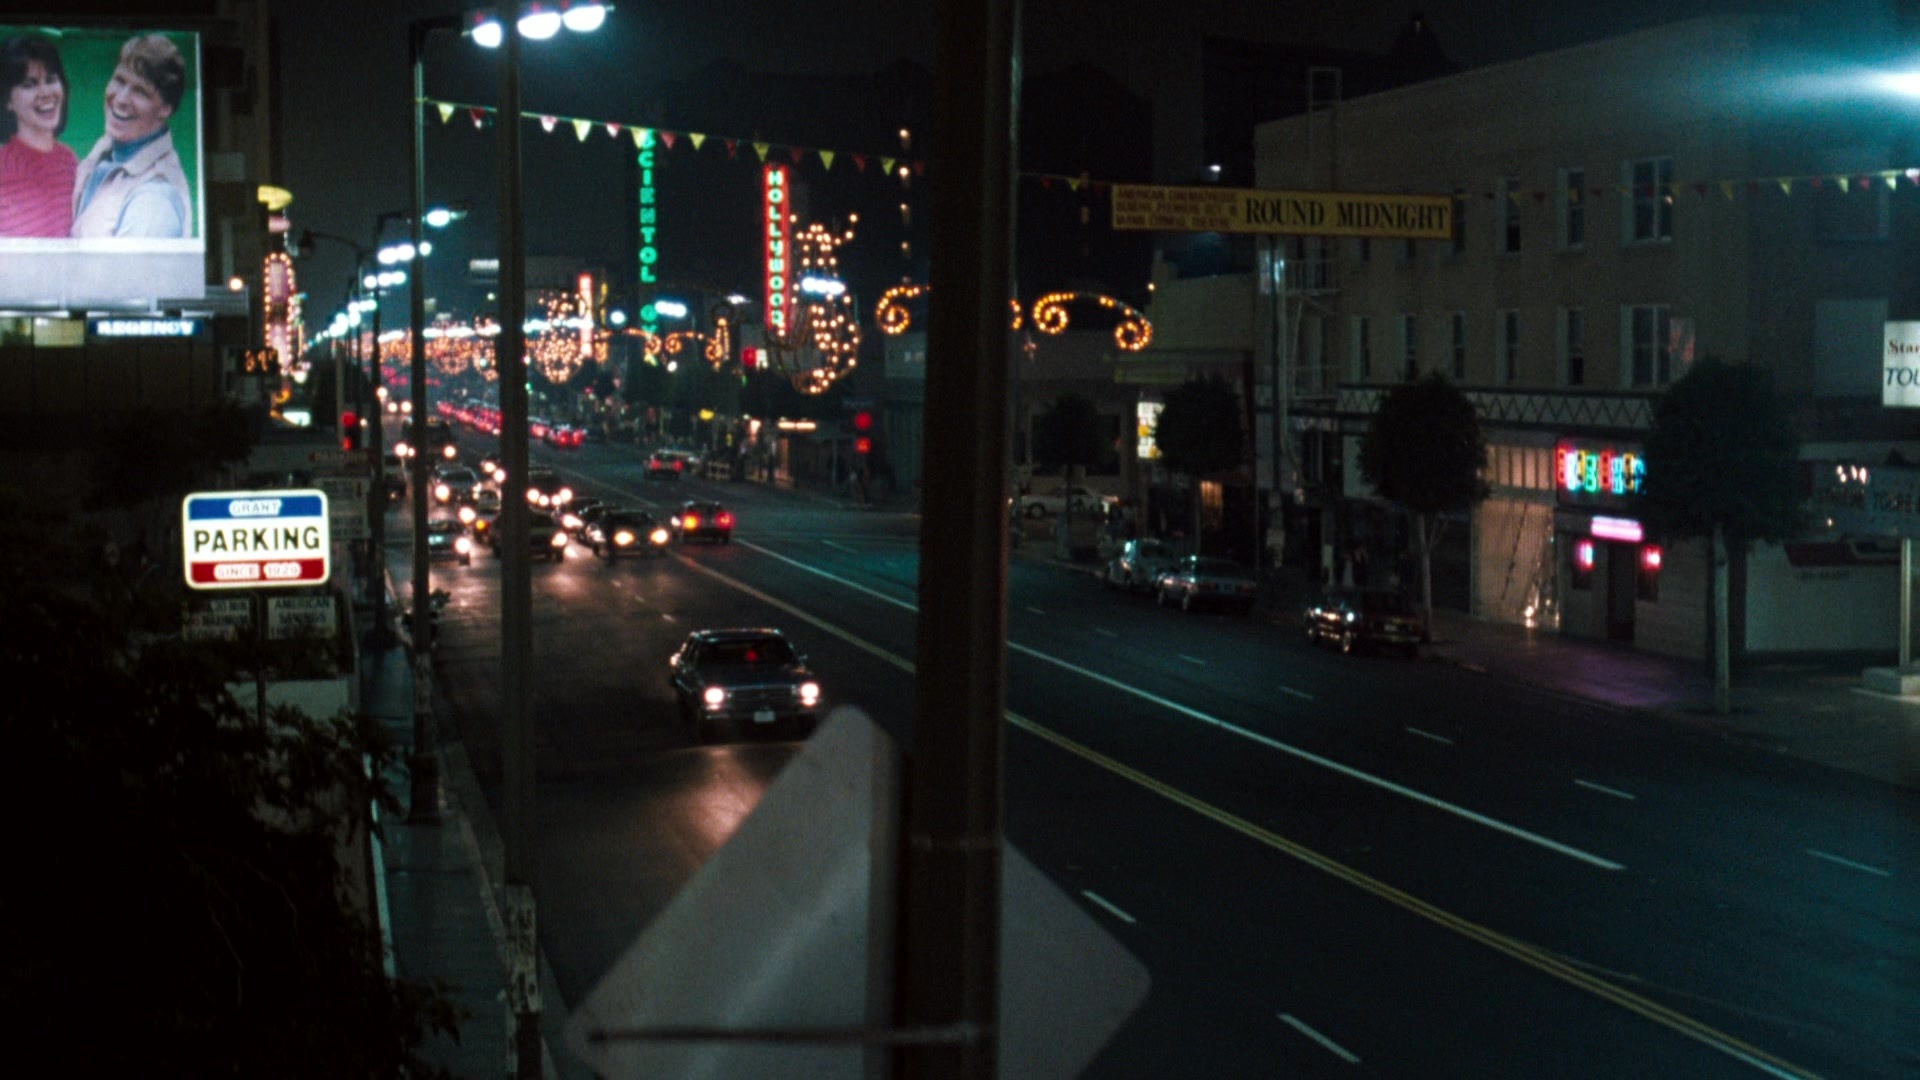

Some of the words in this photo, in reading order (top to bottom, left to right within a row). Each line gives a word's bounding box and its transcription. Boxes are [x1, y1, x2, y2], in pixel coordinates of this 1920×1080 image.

[1245, 197, 1324, 226] ROUND
[1336, 201, 1448, 230] MIDNIGHT
[768, 170, 785, 325] HOLLYWOOD
[231, 501, 280, 515] GRANT
[193, 526, 320, 553] PARKING
[216, 564, 258, 578] SINCE
